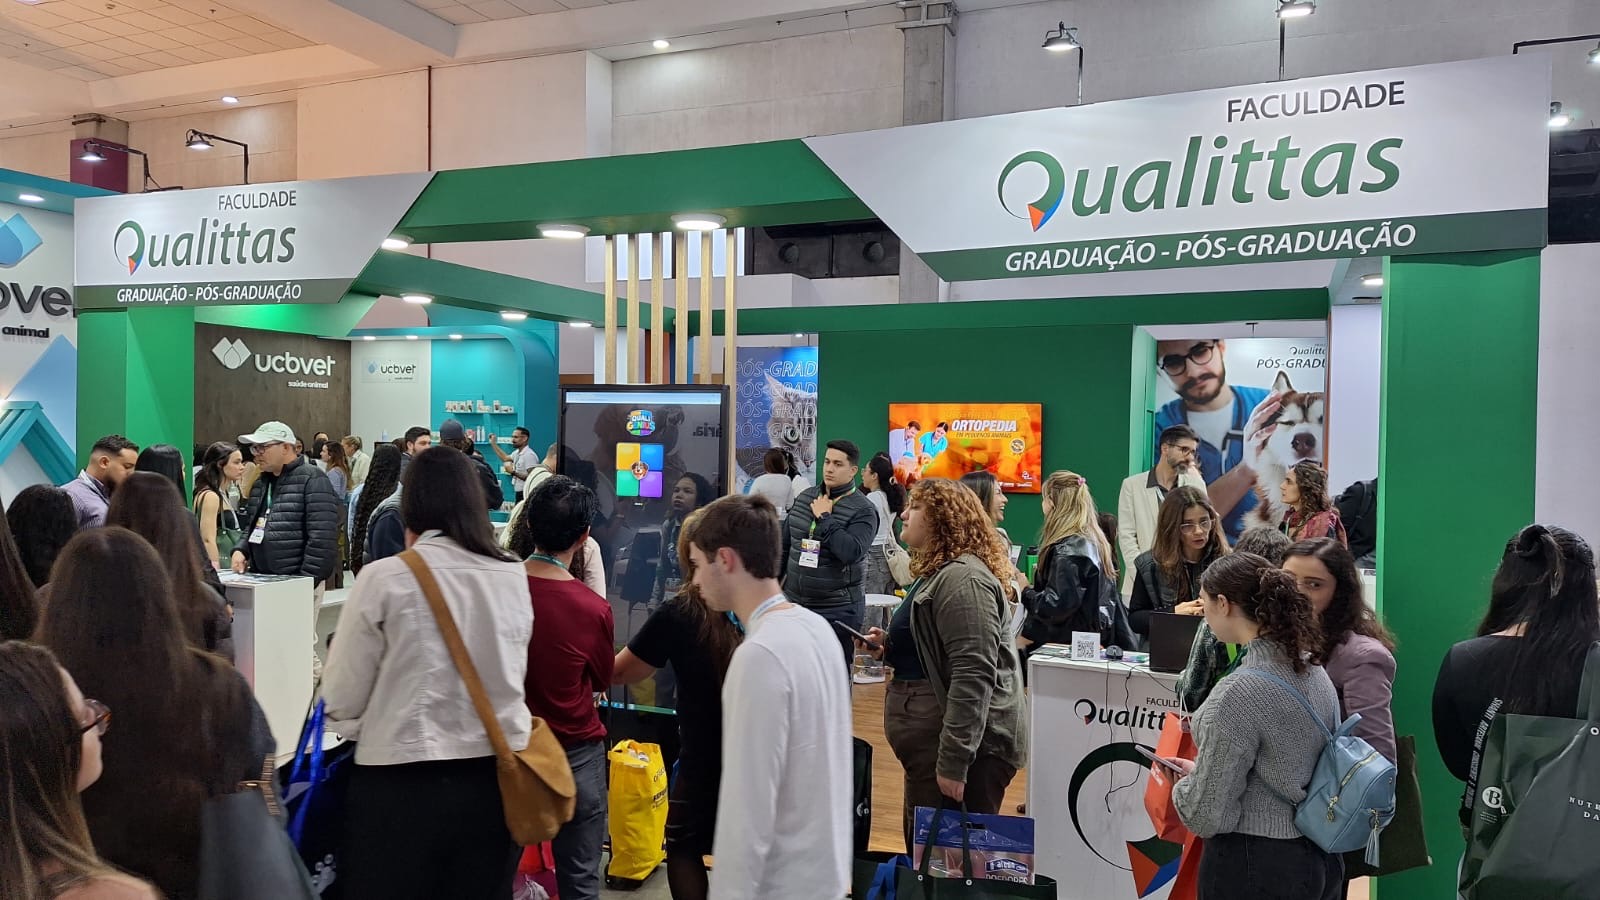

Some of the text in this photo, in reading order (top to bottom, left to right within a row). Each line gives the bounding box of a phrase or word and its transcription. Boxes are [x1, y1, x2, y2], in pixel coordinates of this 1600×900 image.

[1227, 81, 1406, 123] FACULDADE
[998, 135, 1404, 232] Qualittas
[218, 190, 297, 211] FACULDADE
[113, 217, 297, 276] Qualittas
[1004, 241, 1156, 273] GRADUAÇÃO
[1175, 221, 1417, 262] PÓS-GRADUAÇÃO
[117, 284, 187, 305] GRADUAÇÃO
[195, 281, 302, 303] PÓS-GRADUAÇÃO
[2, 325, 50, 338] animal
[255, 351, 336, 376] ucbvet
[380, 364, 417, 374] ucbvet
[951, 419, 1017, 432] ORTOPEDIA
